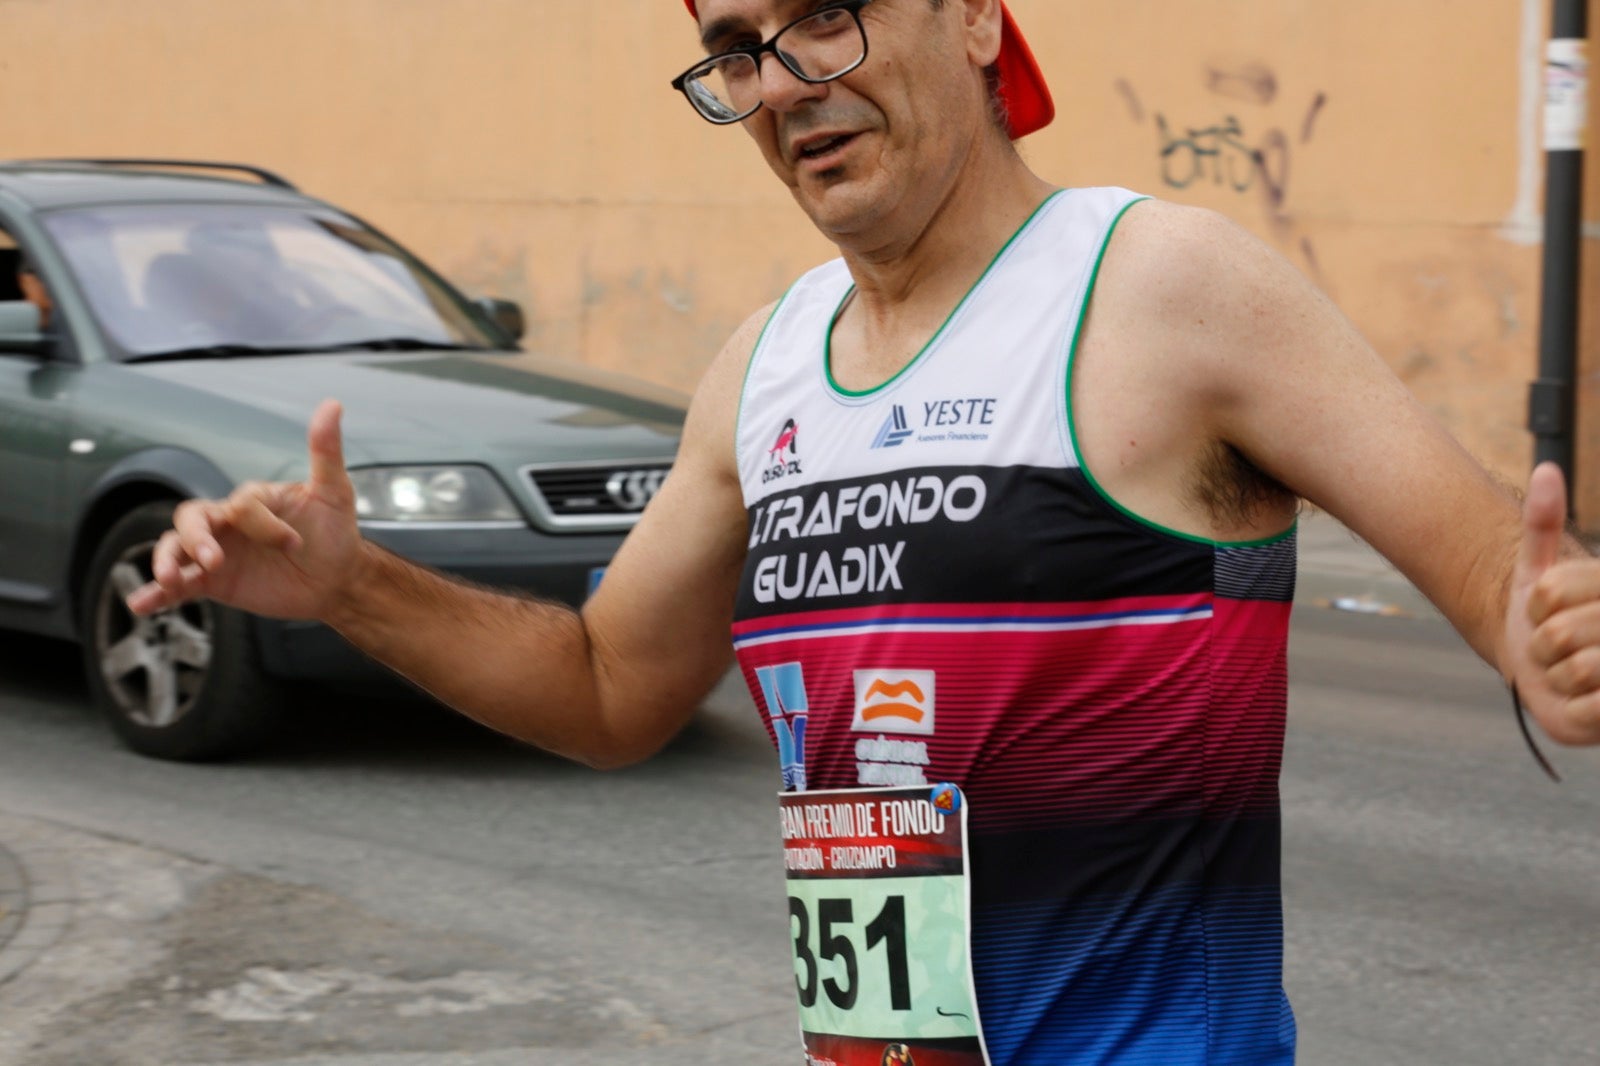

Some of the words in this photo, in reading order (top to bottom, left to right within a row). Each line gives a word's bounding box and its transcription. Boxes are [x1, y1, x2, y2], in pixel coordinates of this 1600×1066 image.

[923, 398, 997, 427] YESTE
[753, 541, 906, 604] GUADIX
[805, 803, 856, 838] PREMIO
[855, 802, 879, 837] DE
[880, 799, 945, 836] FONDO
[830, 845, 897, 870] CRUZCAMPO
